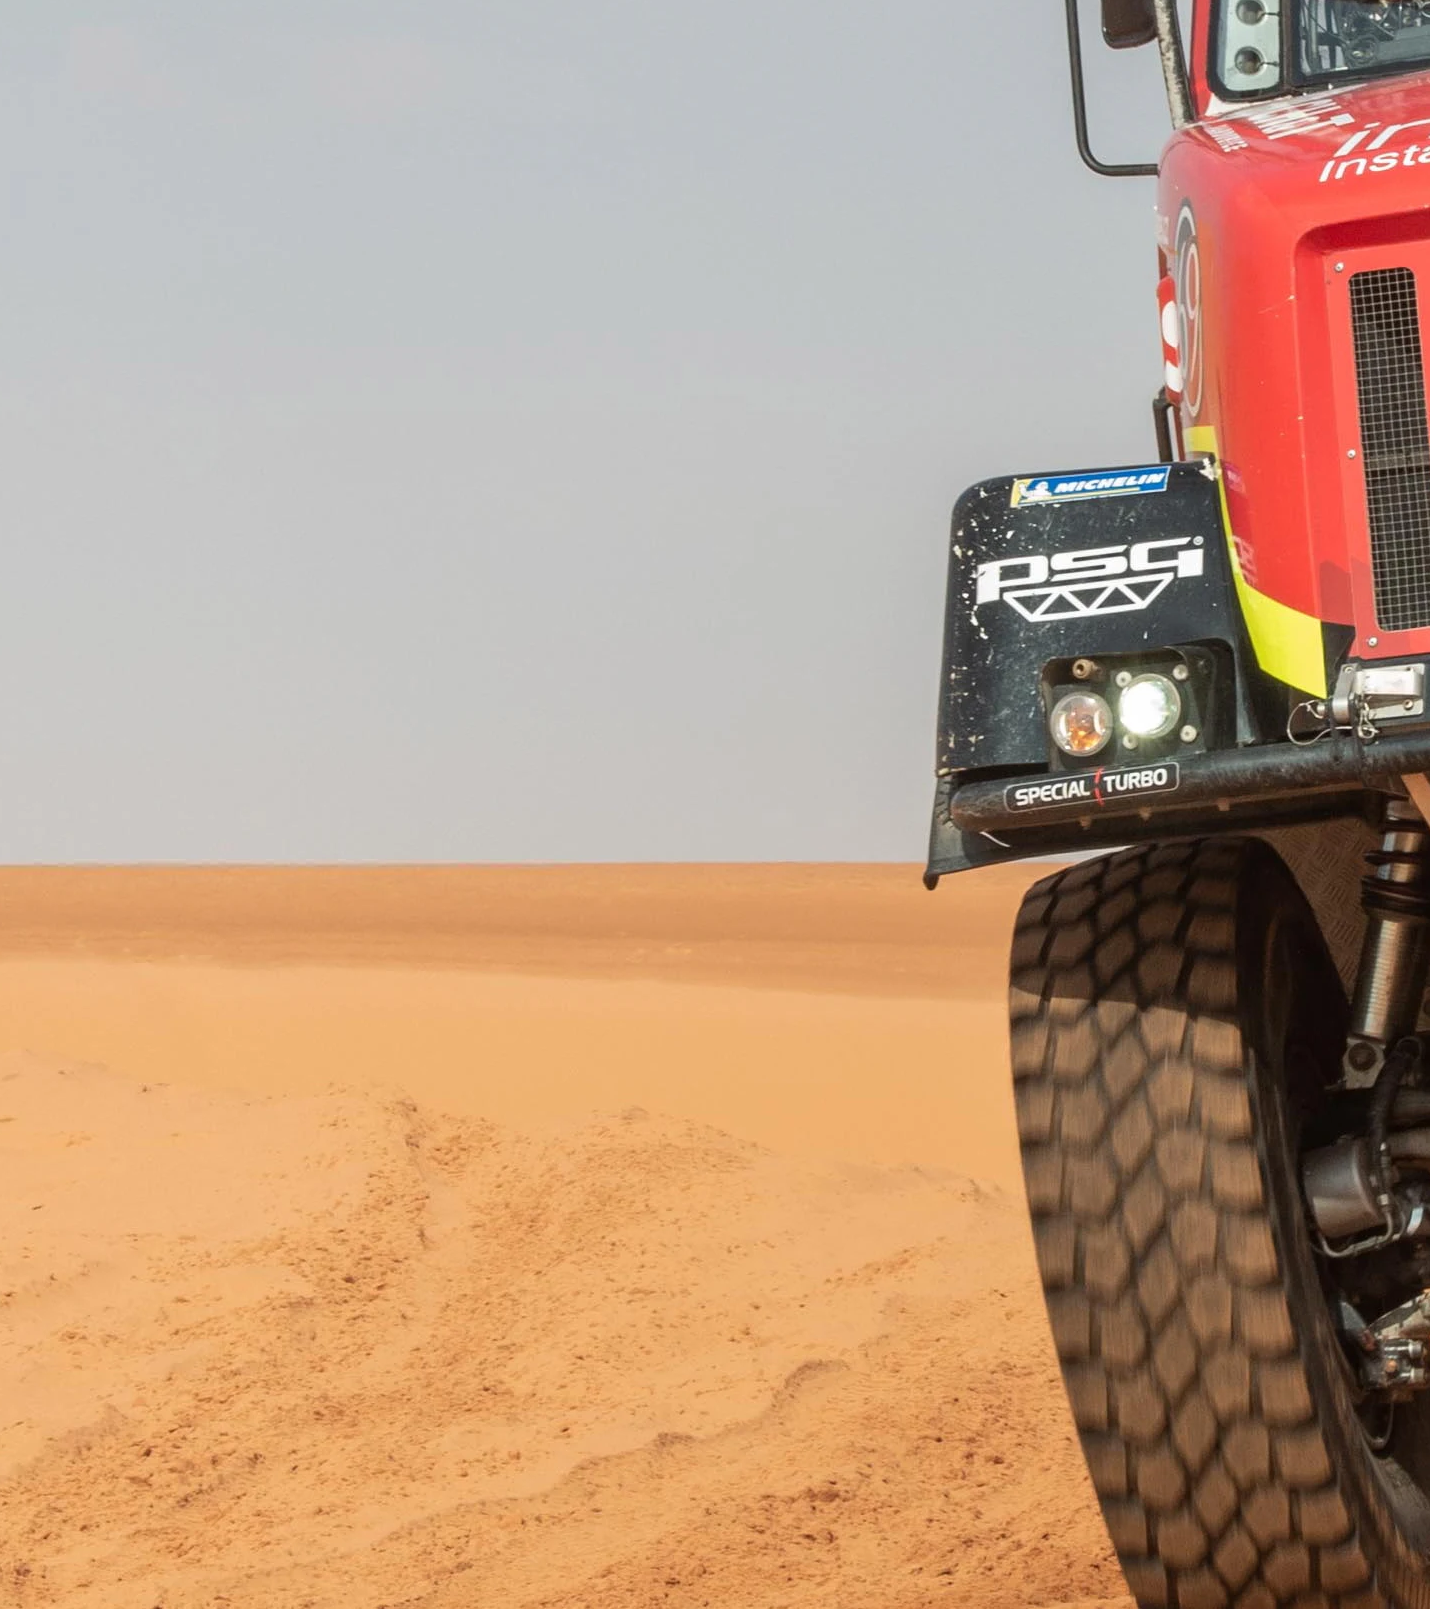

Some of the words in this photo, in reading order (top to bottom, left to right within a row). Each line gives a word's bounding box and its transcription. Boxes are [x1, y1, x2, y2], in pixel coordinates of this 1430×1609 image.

[1054, 471, 1165, 494] MICHELIN
[1015, 780, 1090, 807] SPECIAL
[1103, 768, 1168, 793] TURBO
